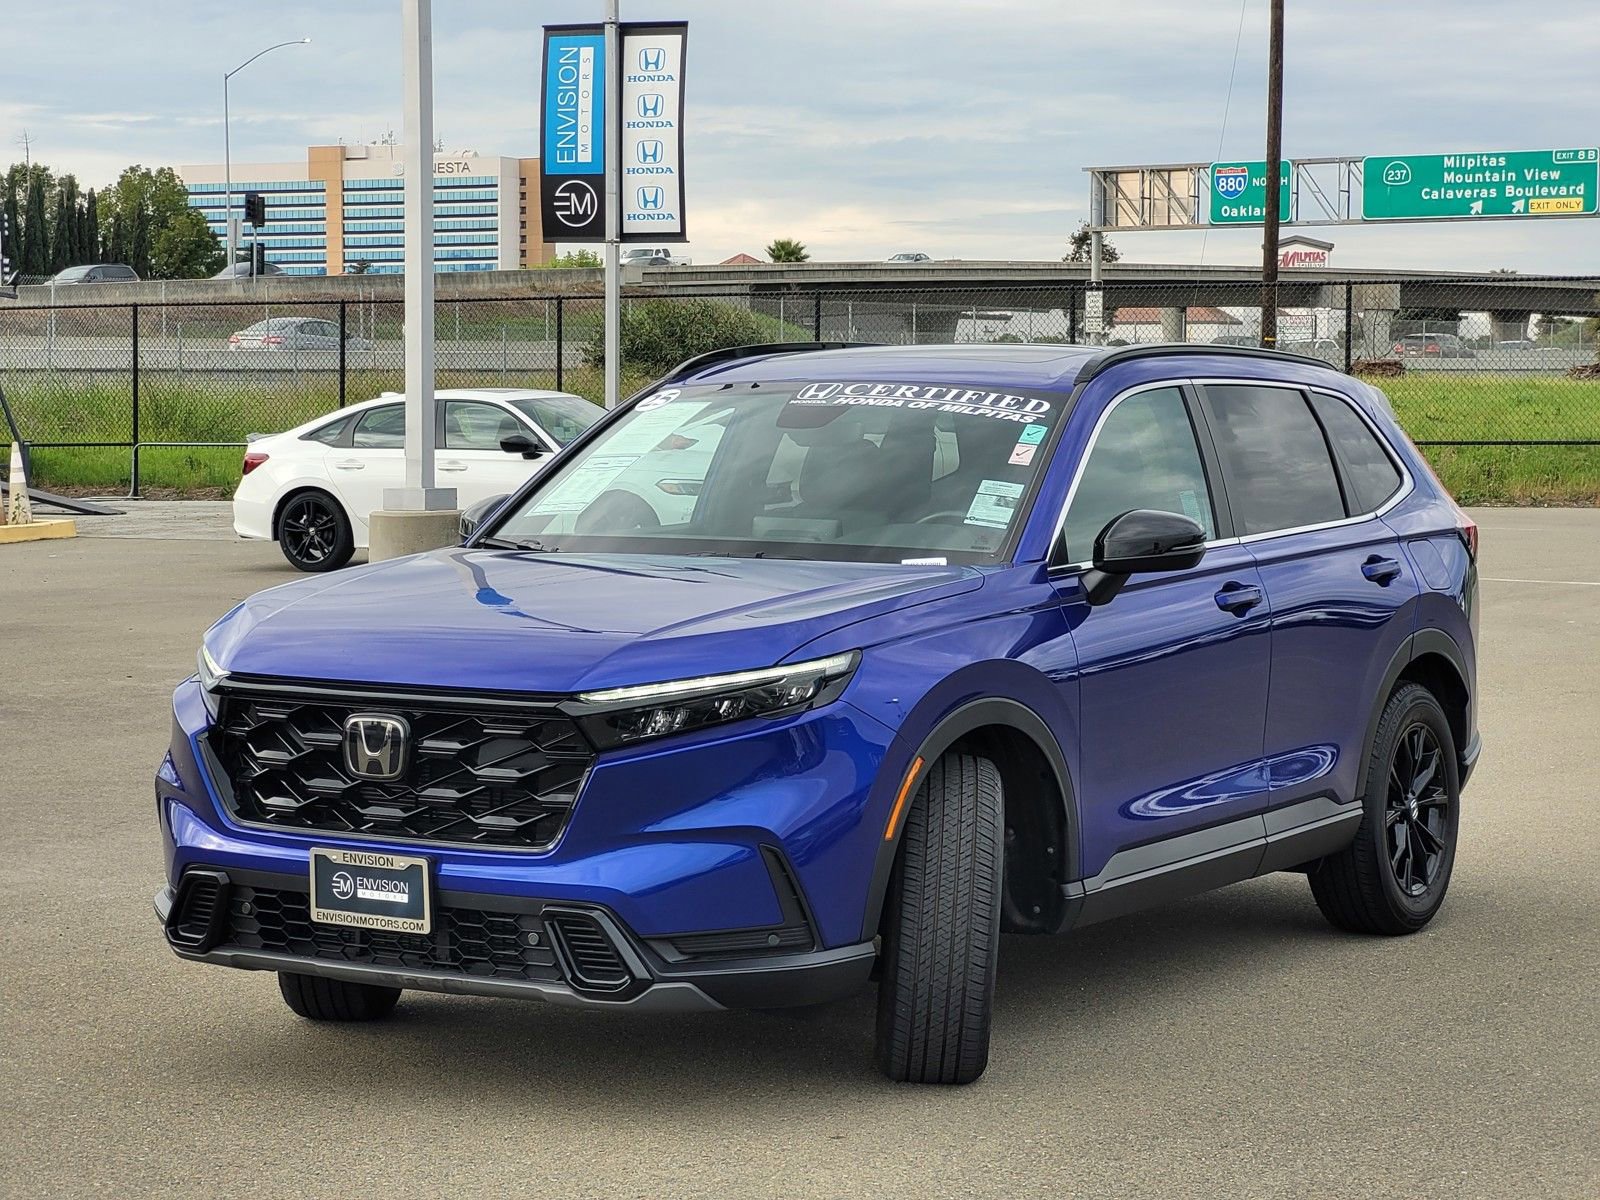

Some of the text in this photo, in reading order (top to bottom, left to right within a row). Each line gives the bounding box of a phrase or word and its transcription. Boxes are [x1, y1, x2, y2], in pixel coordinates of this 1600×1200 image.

[627, 75, 675, 83] HONDA
[557, 47, 579, 163] ENVISION
[581, 57, 591, 153] MOTORS
[625, 121, 674, 129] HONDA
[1443, 155, 1506, 170] Milpitas
[1556, 152, 1574, 160] EXIT
[432, 162, 471, 174] ESTA
[626, 167, 674, 175] HONDA
[1387, 169, 1407, 181] 237
[1252, 176, 1288, 187] NOH
[1443, 168, 1561, 184] Mountain View
[1218, 177, 1245, 191] 880
[1421, 183, 1585, 200] Calaveras Boulevard
[1221, 205, 1267, 217] Oakla
[1530, 200, 1582, 210] EXIT ONLY
[626, 213, 675, 221] HONDA
[844, 383, 1051, 413] CERTIFIED
[832, 397, 1038, 423] HONDA OF MILPITAS
[342, 852, 394, 868] ENVISION
[356, 876, 409, 894] ENVISION
[316, 911, 425, 932] ENVISIONMOTORS.COM
